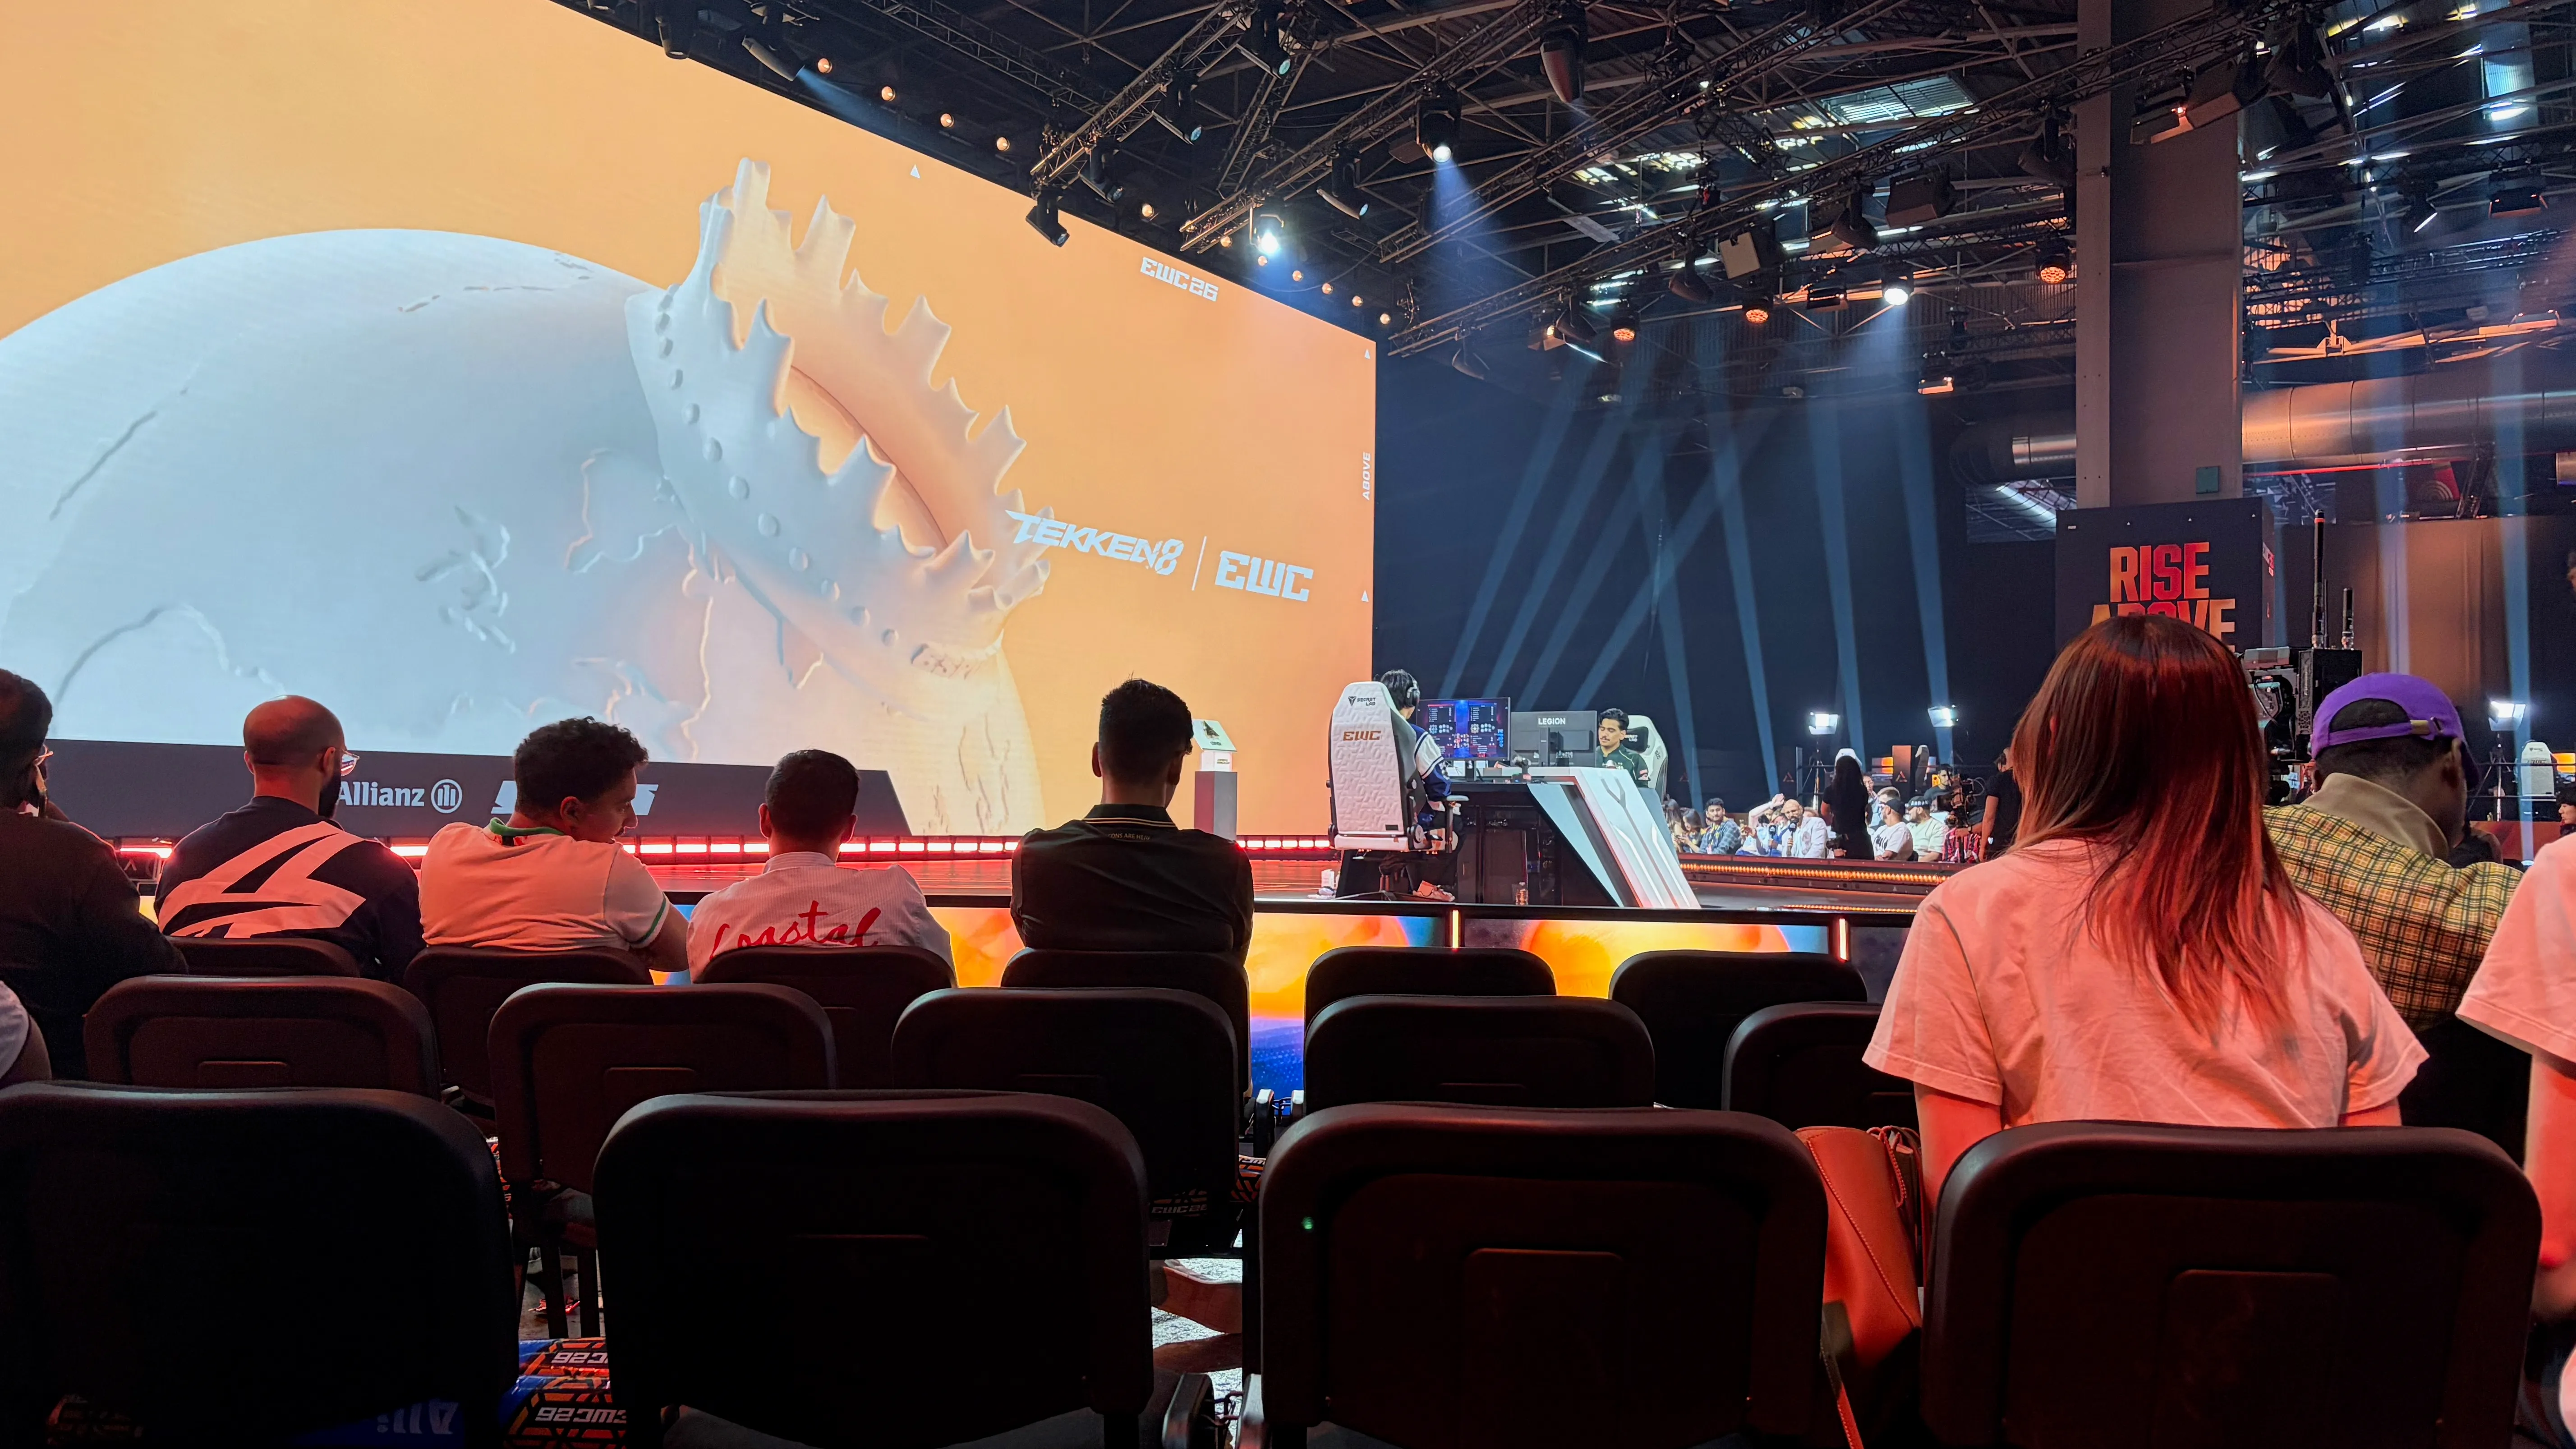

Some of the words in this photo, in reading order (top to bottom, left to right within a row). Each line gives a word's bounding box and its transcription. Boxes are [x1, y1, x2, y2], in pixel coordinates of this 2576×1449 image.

[1362, 452, 1371, 500] ABOVE
[1215, 550, 1314, 602] EWC
[2110, 542, 2209, 603] RISE
[1343, 730, 1381, 741] EWC
[339, 781, 425, 807] Allianz
